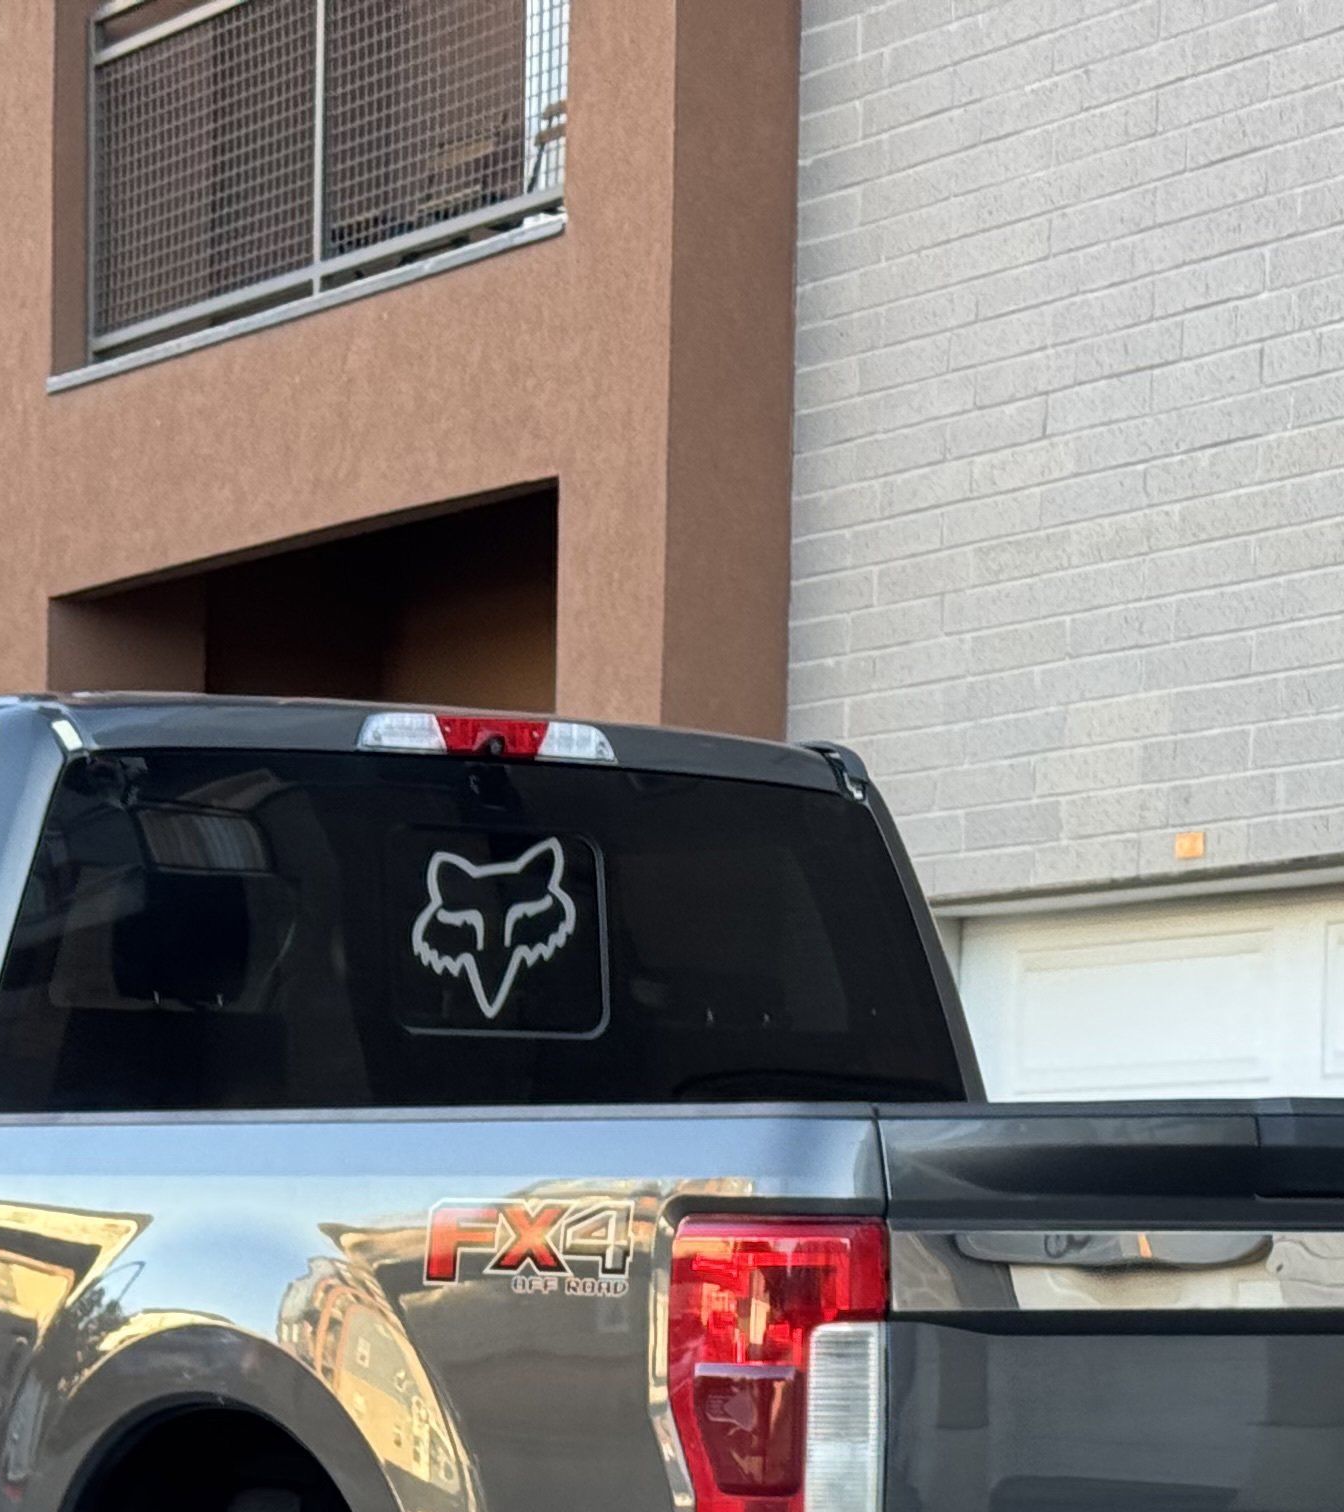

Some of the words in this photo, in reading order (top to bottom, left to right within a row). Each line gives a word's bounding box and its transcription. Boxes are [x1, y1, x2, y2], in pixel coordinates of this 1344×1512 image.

[424, 1198, 635, 1286] FX4
[511, 1275, 557, 1294] OFF
[564, 1275, 629, 1296] ROAD
